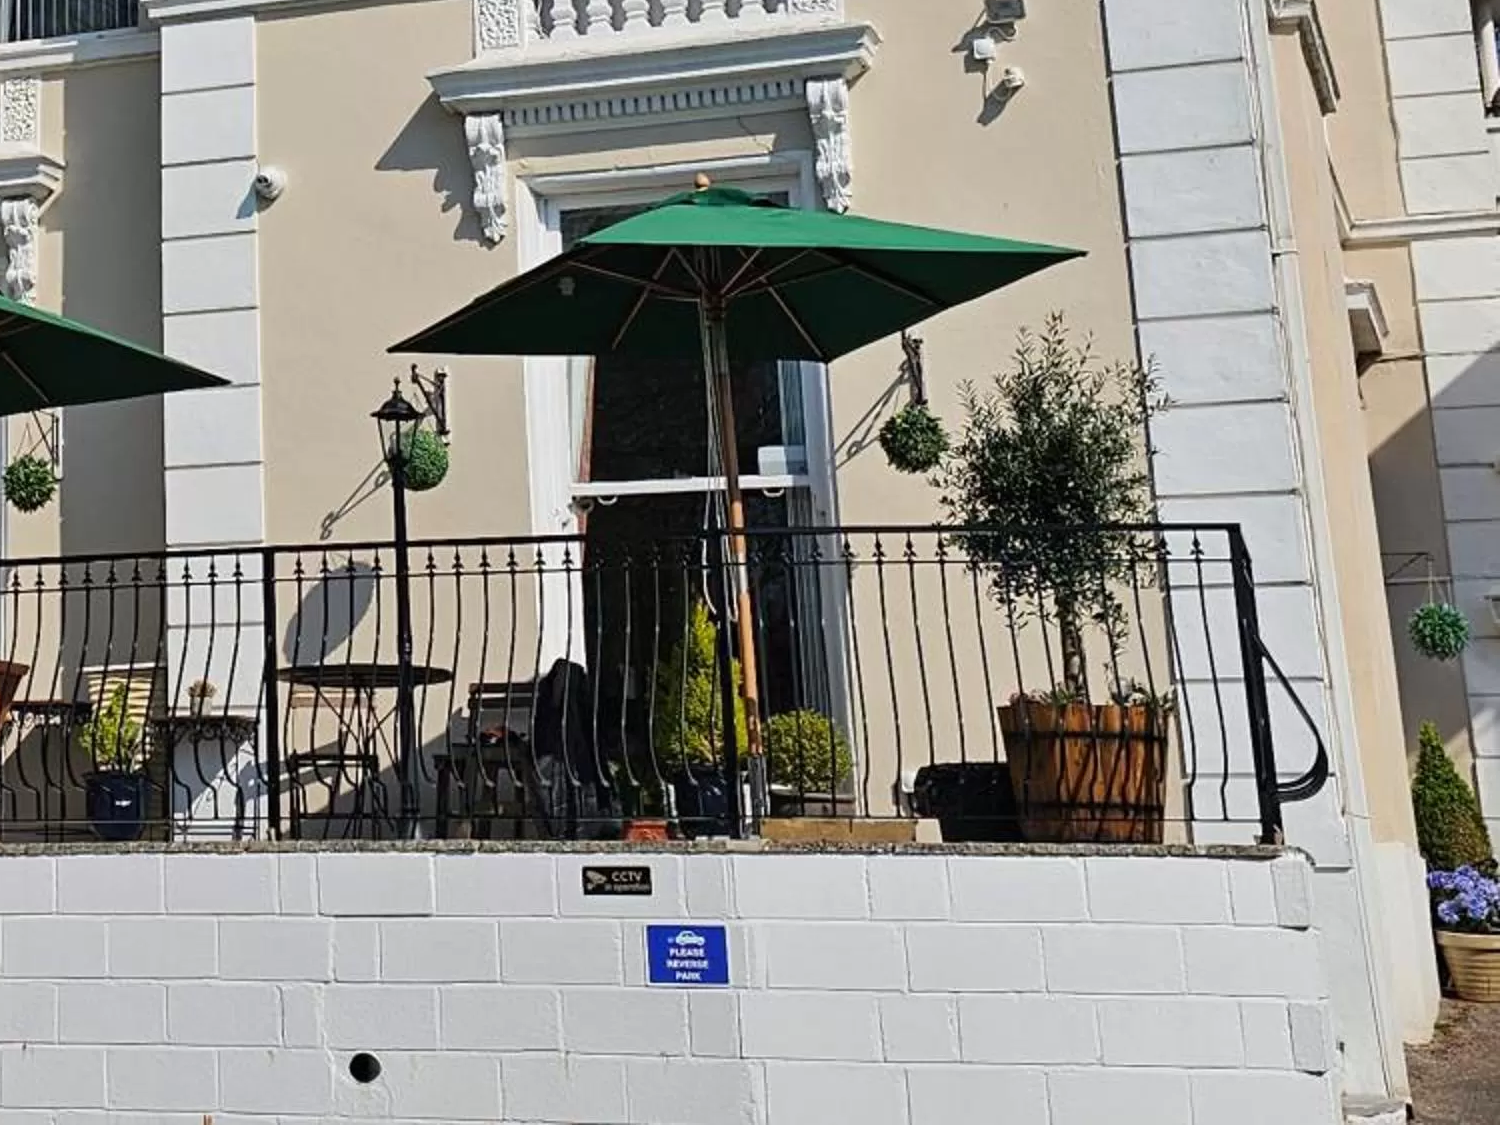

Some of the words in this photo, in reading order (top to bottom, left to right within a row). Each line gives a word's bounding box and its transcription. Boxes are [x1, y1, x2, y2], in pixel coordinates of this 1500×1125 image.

[611, 871, 643, 882] CCTV
[669, 948, 705, 957] PLEASE
[666, 959, 708, 969] REVERSE
[675, 970, 702, 981] PARK
